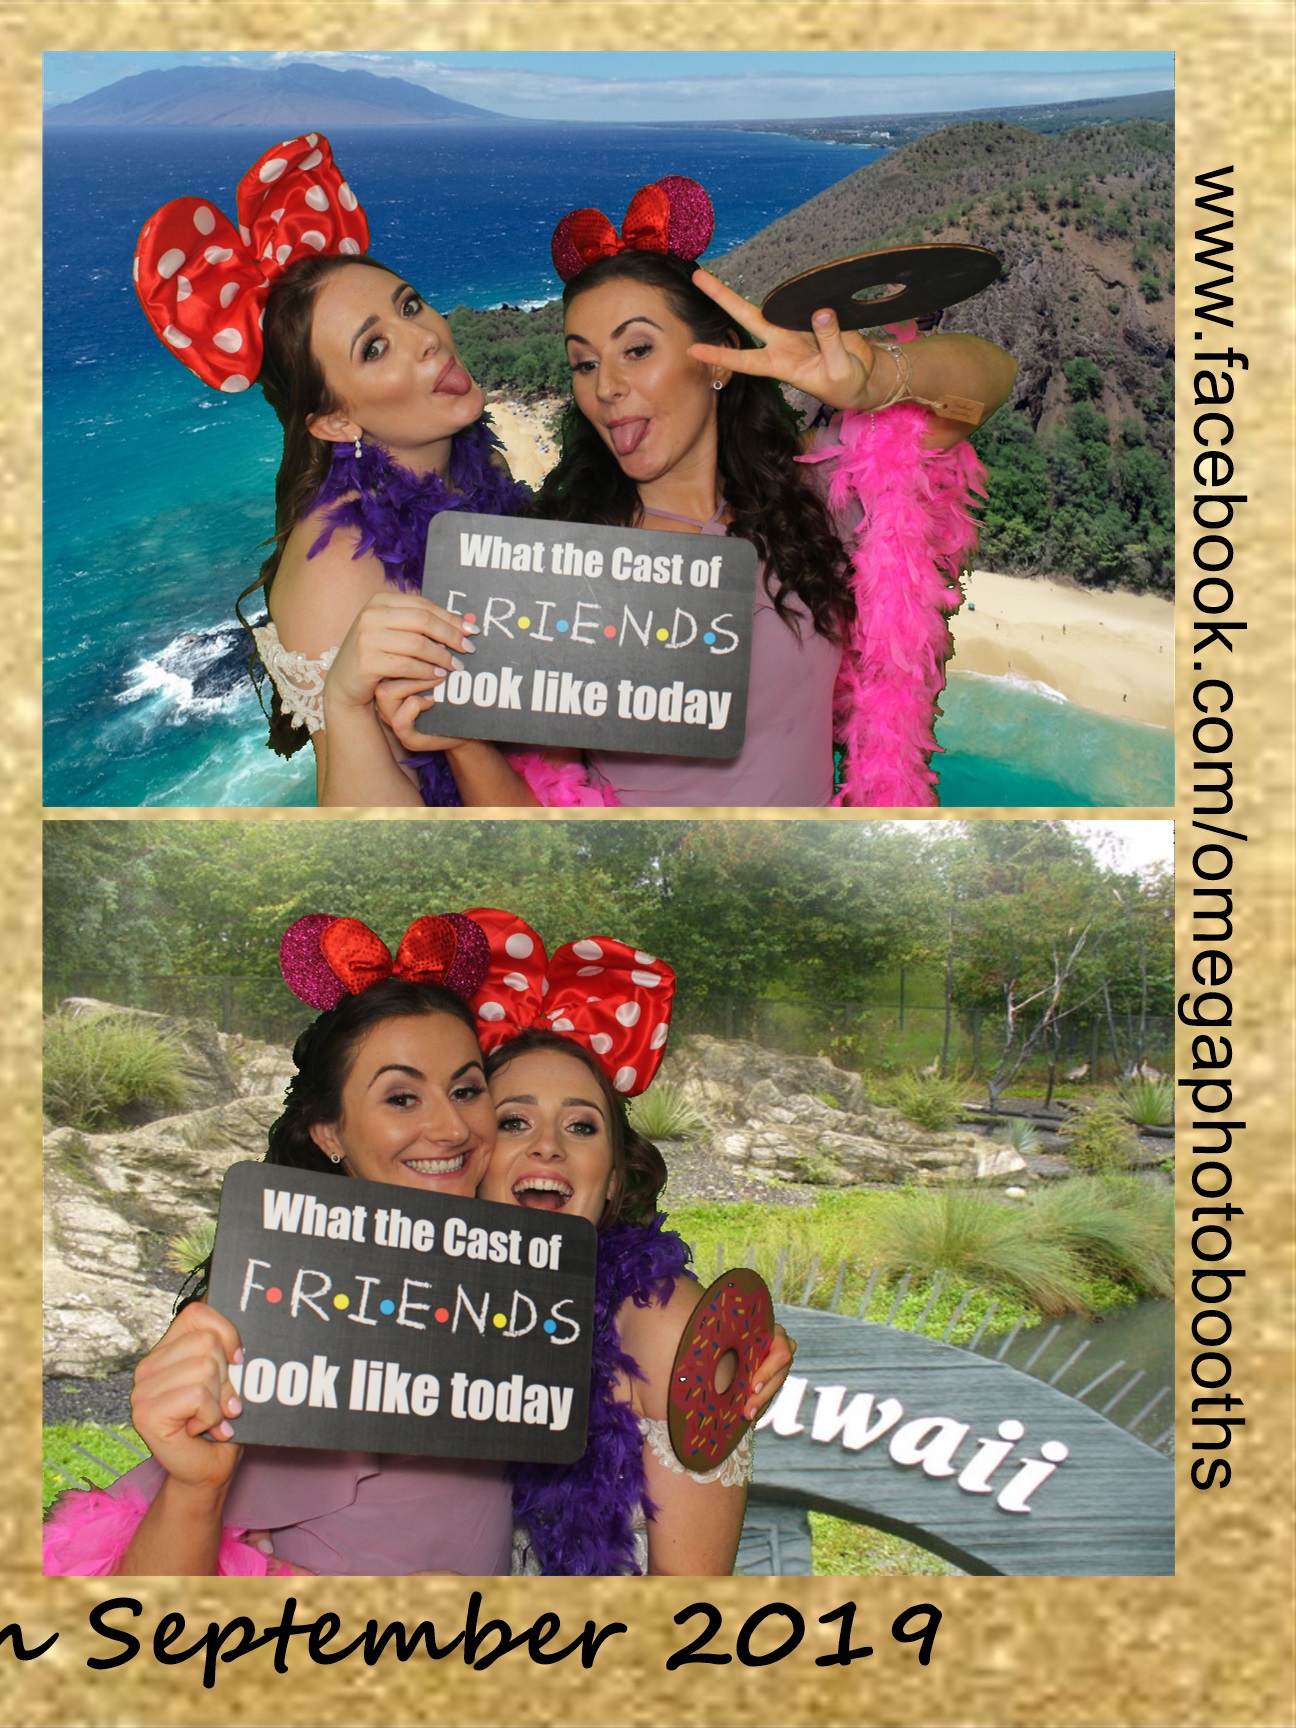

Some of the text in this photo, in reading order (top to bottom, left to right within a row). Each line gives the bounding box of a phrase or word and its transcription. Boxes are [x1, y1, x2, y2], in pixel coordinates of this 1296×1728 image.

[459, 532, 723, 589] What the Cast of
[530, 669, 609, 718] like
[617, 679, 733, 731] today
[263, 1188, 563, 1271] What the Cast of
[349, 1358, 440, 1417] like
[450, 1372, 575, 1432] today
[754, 1374, 1070, 1513] waii
